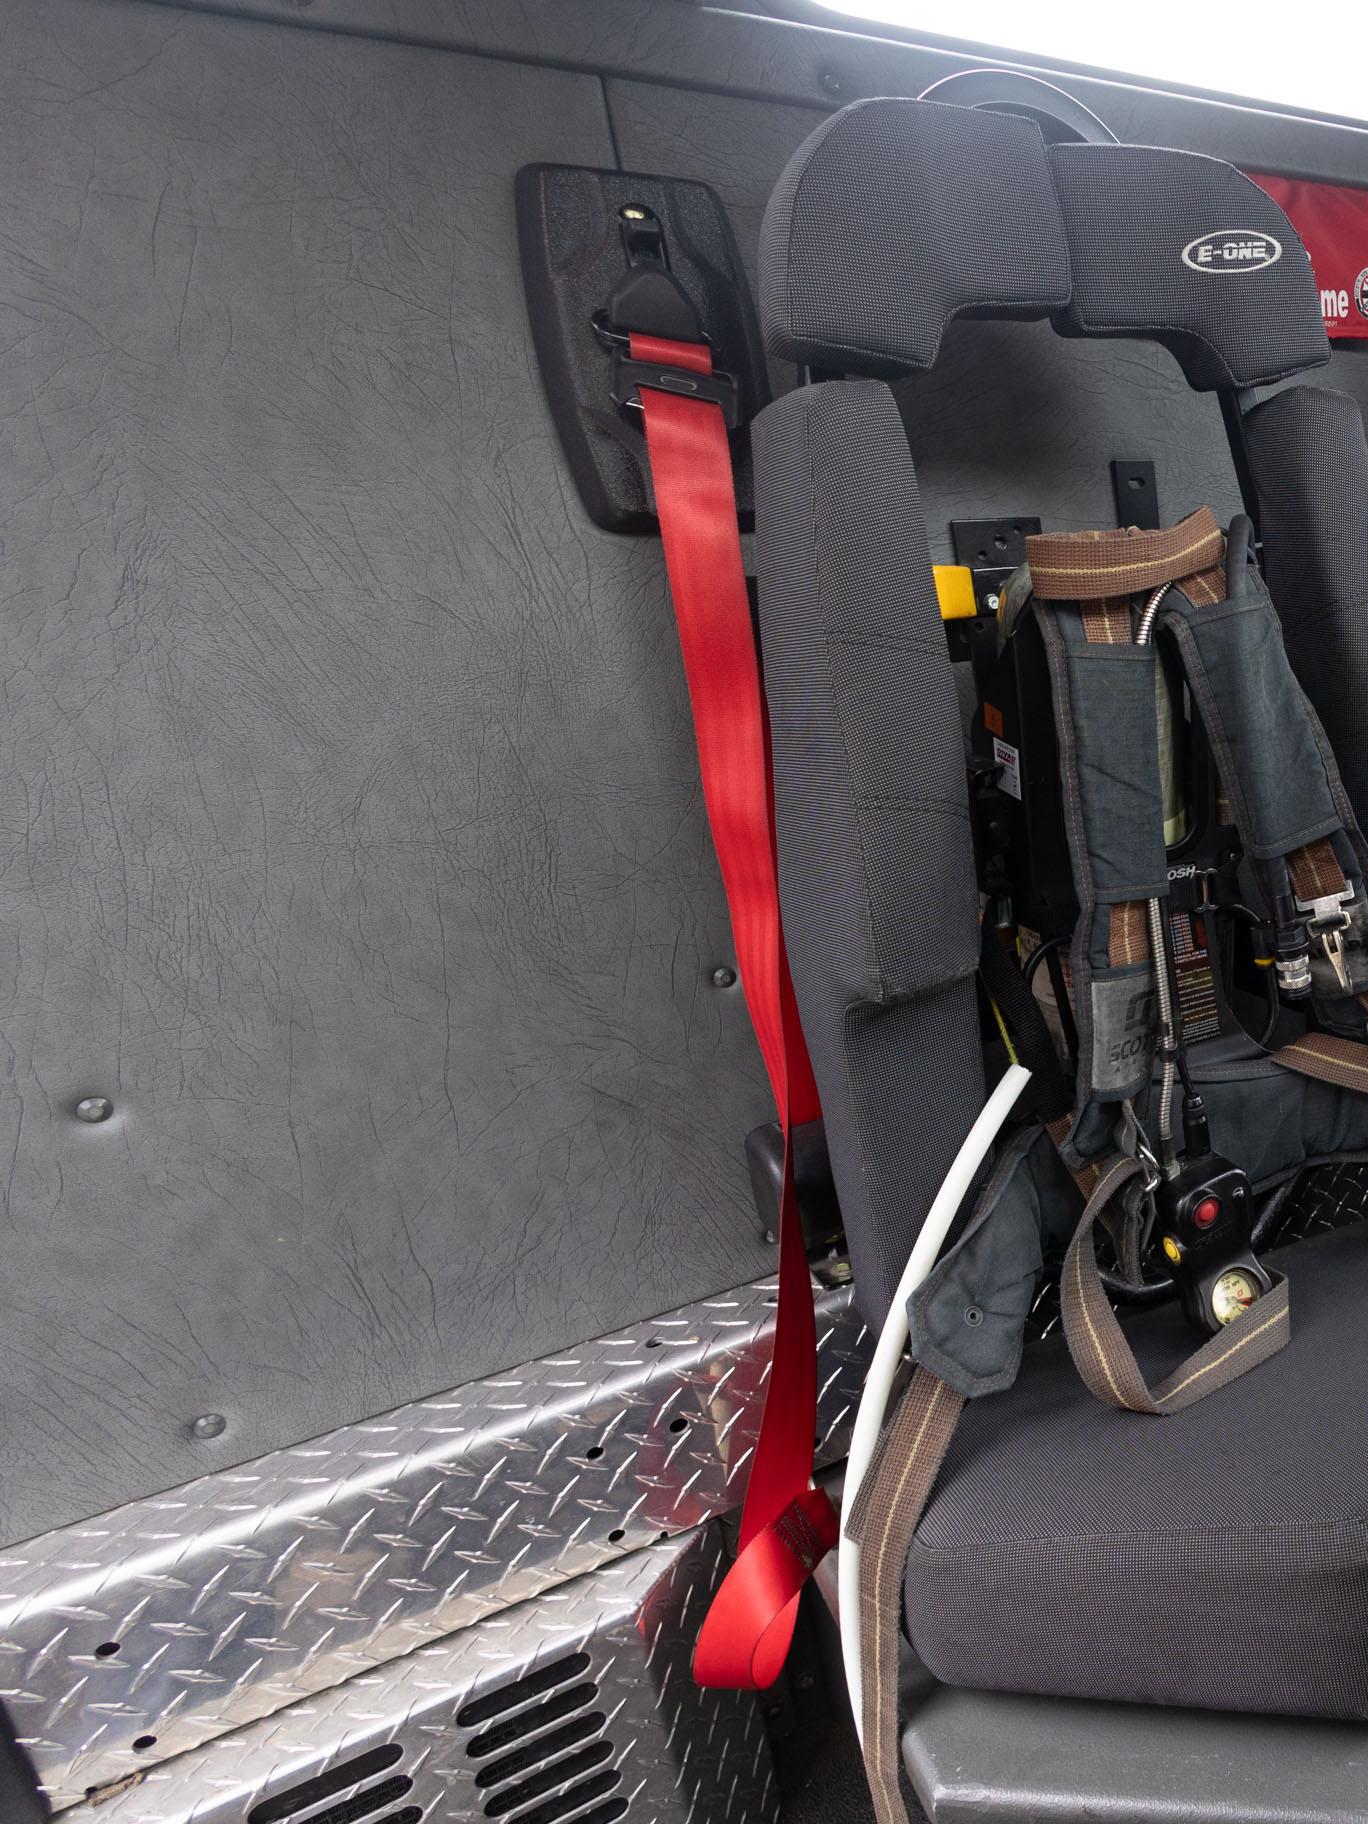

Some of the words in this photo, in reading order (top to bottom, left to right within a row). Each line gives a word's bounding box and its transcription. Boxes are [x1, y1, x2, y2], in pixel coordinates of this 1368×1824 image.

[1197, 241, 1267, 263] E-ONE
[1320, 289, 1349, 318] me
[1167, 866, 1197, 881] OSH
[1109, 1033, 1151, 1063] SCOT
